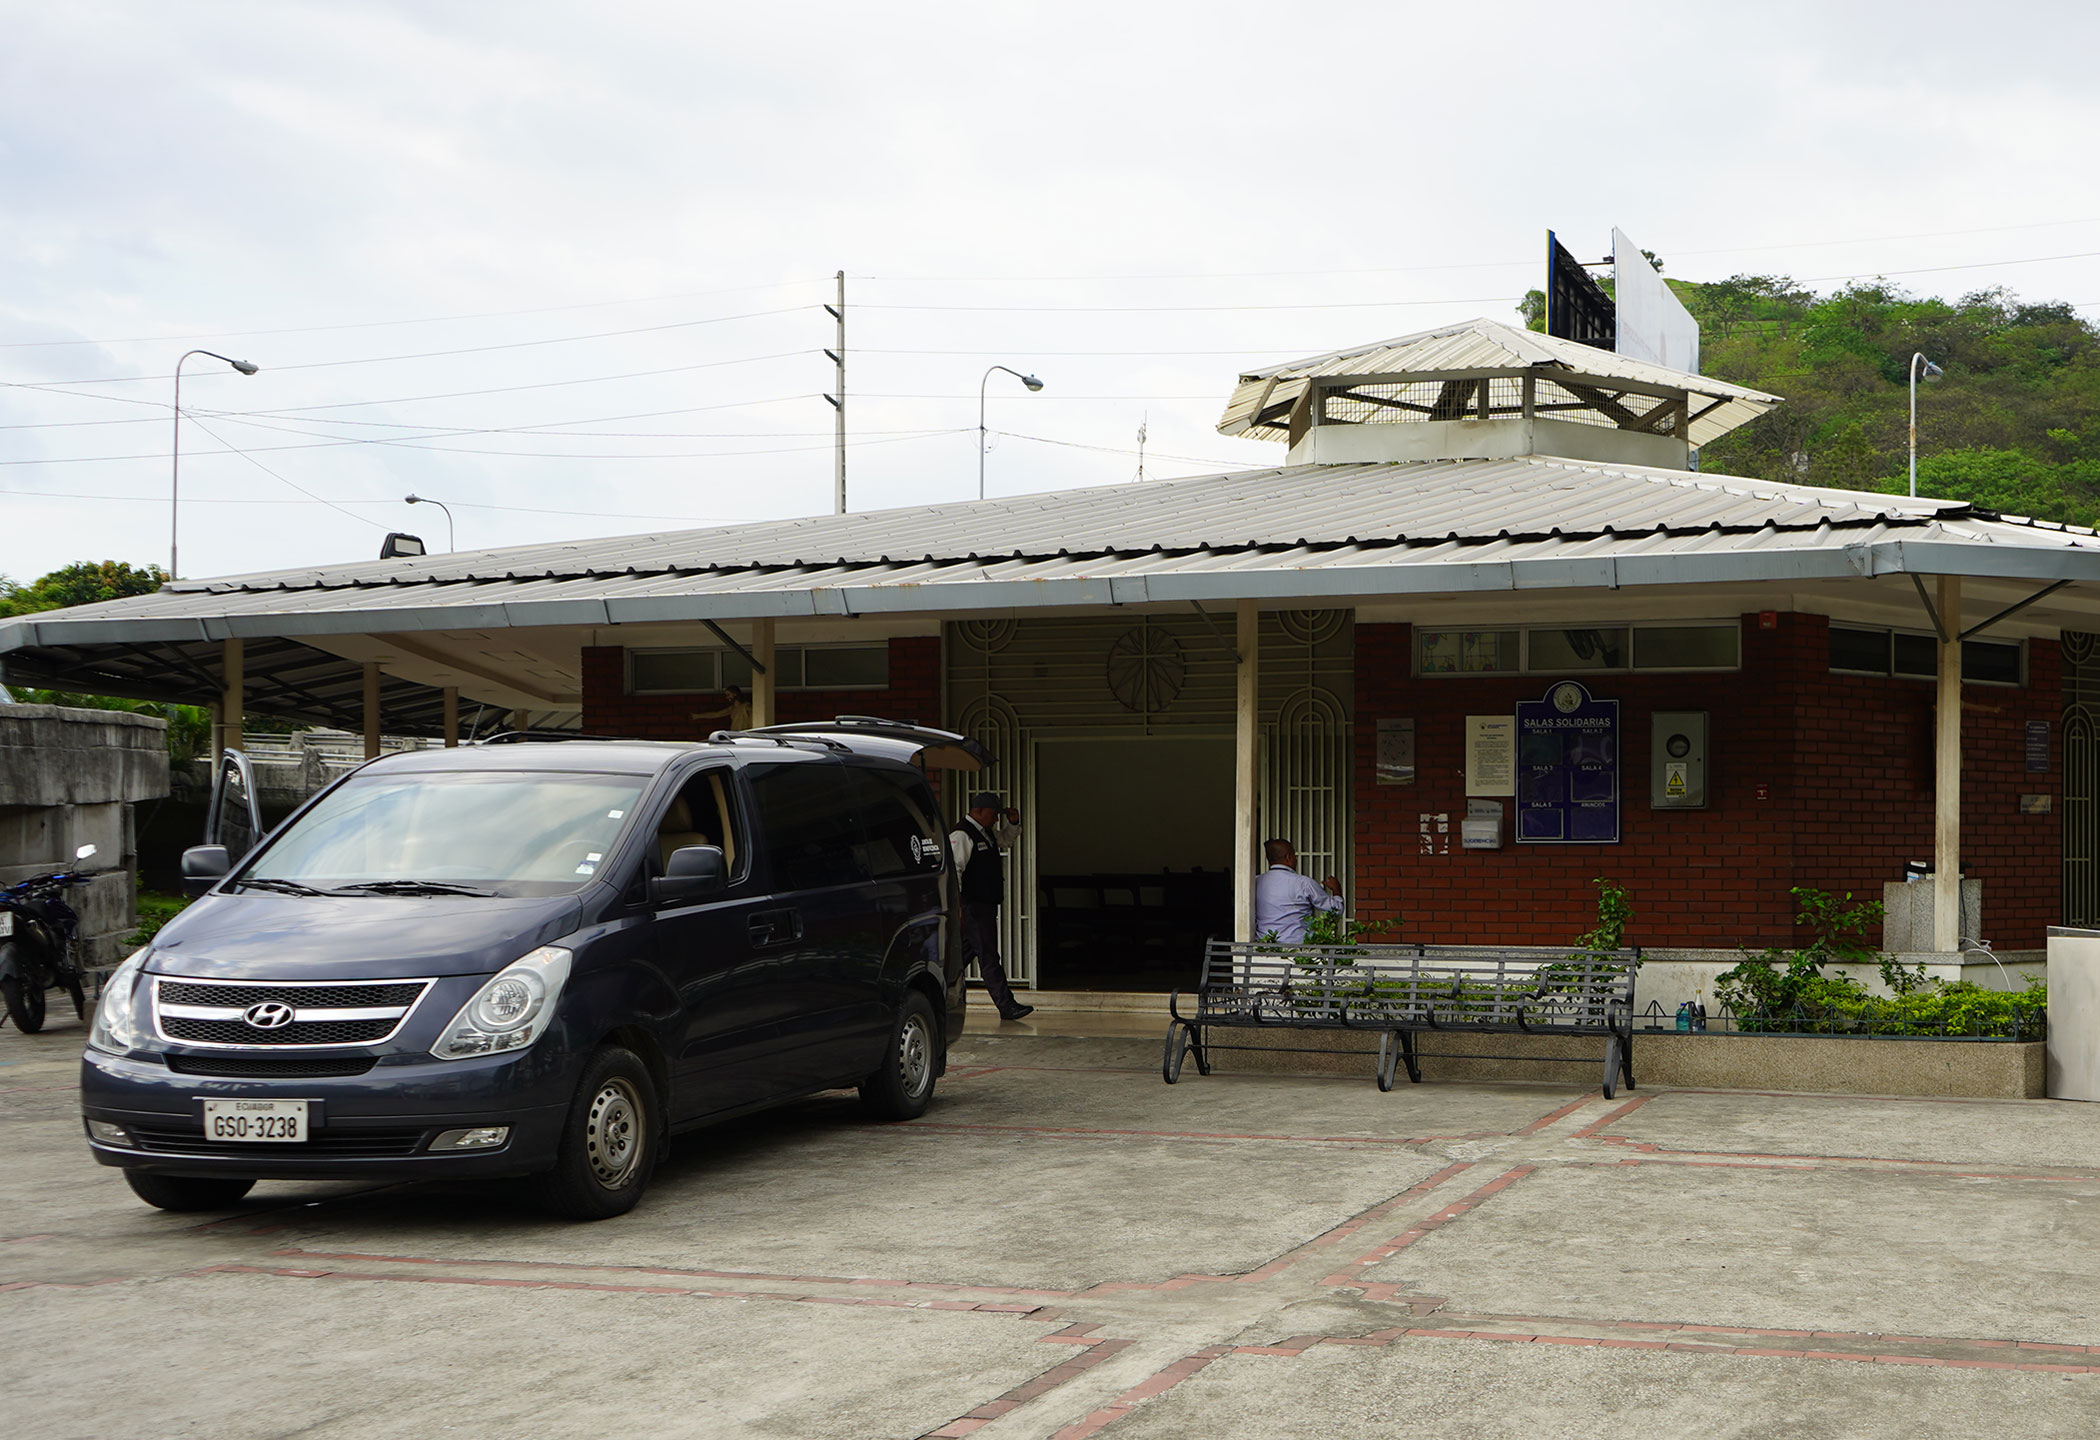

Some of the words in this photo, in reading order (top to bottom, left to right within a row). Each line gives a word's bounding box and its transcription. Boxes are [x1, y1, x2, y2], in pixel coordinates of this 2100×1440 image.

[1523, 719, 1554, 728] SALAS
[1556, 717, 1611, 728] SOLIDARIAS
[236, 1102, 275, 1111] ECUADOR
[215, 1116, 296, 1138] GSO-3238
